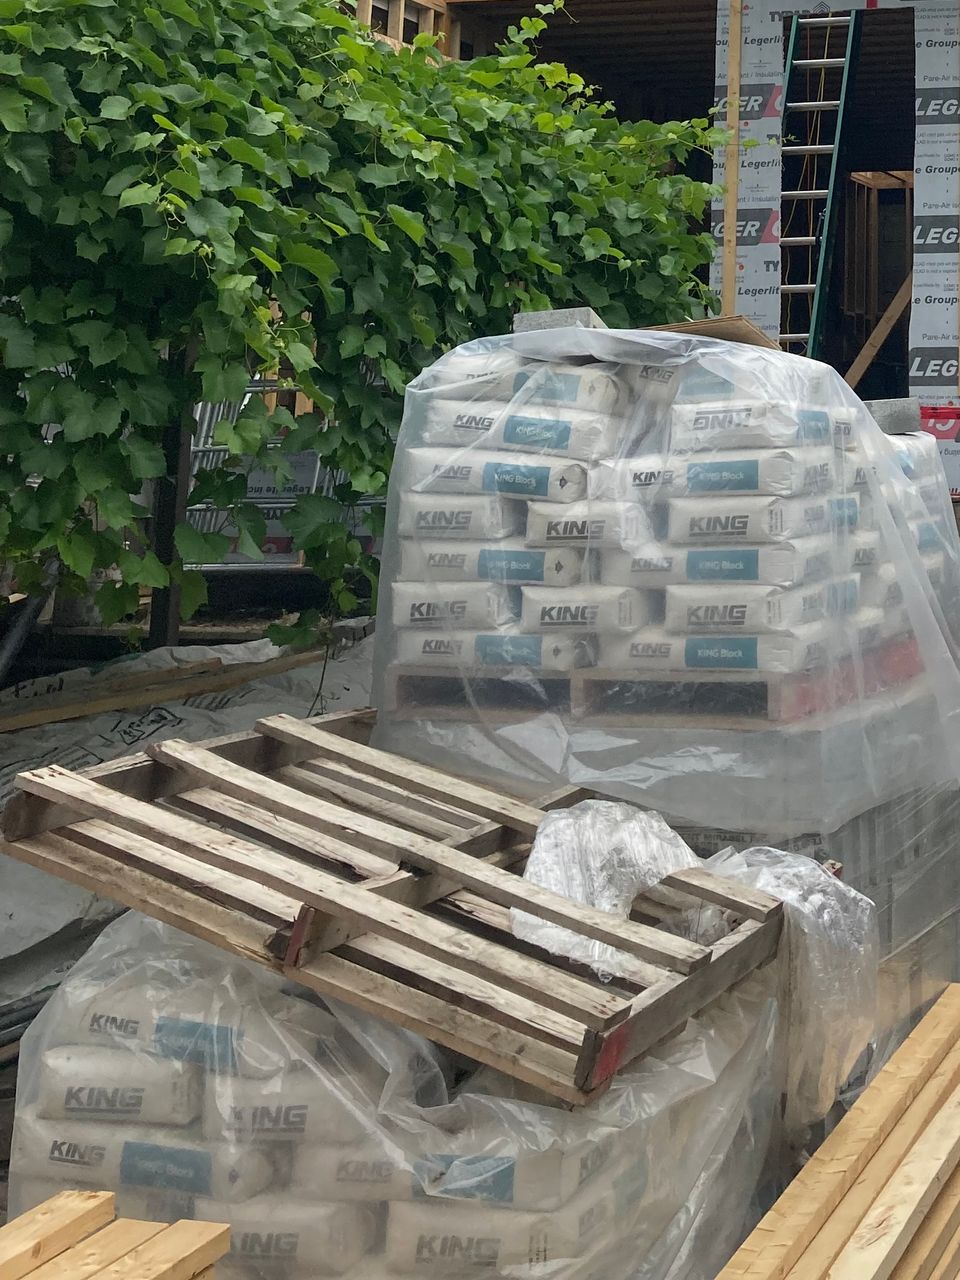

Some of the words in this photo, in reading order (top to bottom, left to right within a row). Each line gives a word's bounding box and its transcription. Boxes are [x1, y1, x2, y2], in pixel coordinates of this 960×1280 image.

[925, 39, 960, 50] Group
[922, 201, 950, 210] Pare-Air
[925, 294, 960, 306] Group
[922, 332, 950, 342] Pare-Air
[455, 414, 495, 428] KING
[632, 471, 674, 484] KING
[415, 511, 472, 526] KING
[689, 515, 749, 532] KING
[546, 520, 606, 536] KING
[428, 552, 467, 565] KING
[410, 600, 467, 617] KING
[541, 605, 599, 621] KING
[687, 605, 748, 621] KING
[630, 642, 673, 655] KING
[90, 1013, 139, 1035] KING
[65, 1086, 144, 1108] KING
[51, 1140, 106, 1163] KING
[416, 1234, 502, 1258] KING
